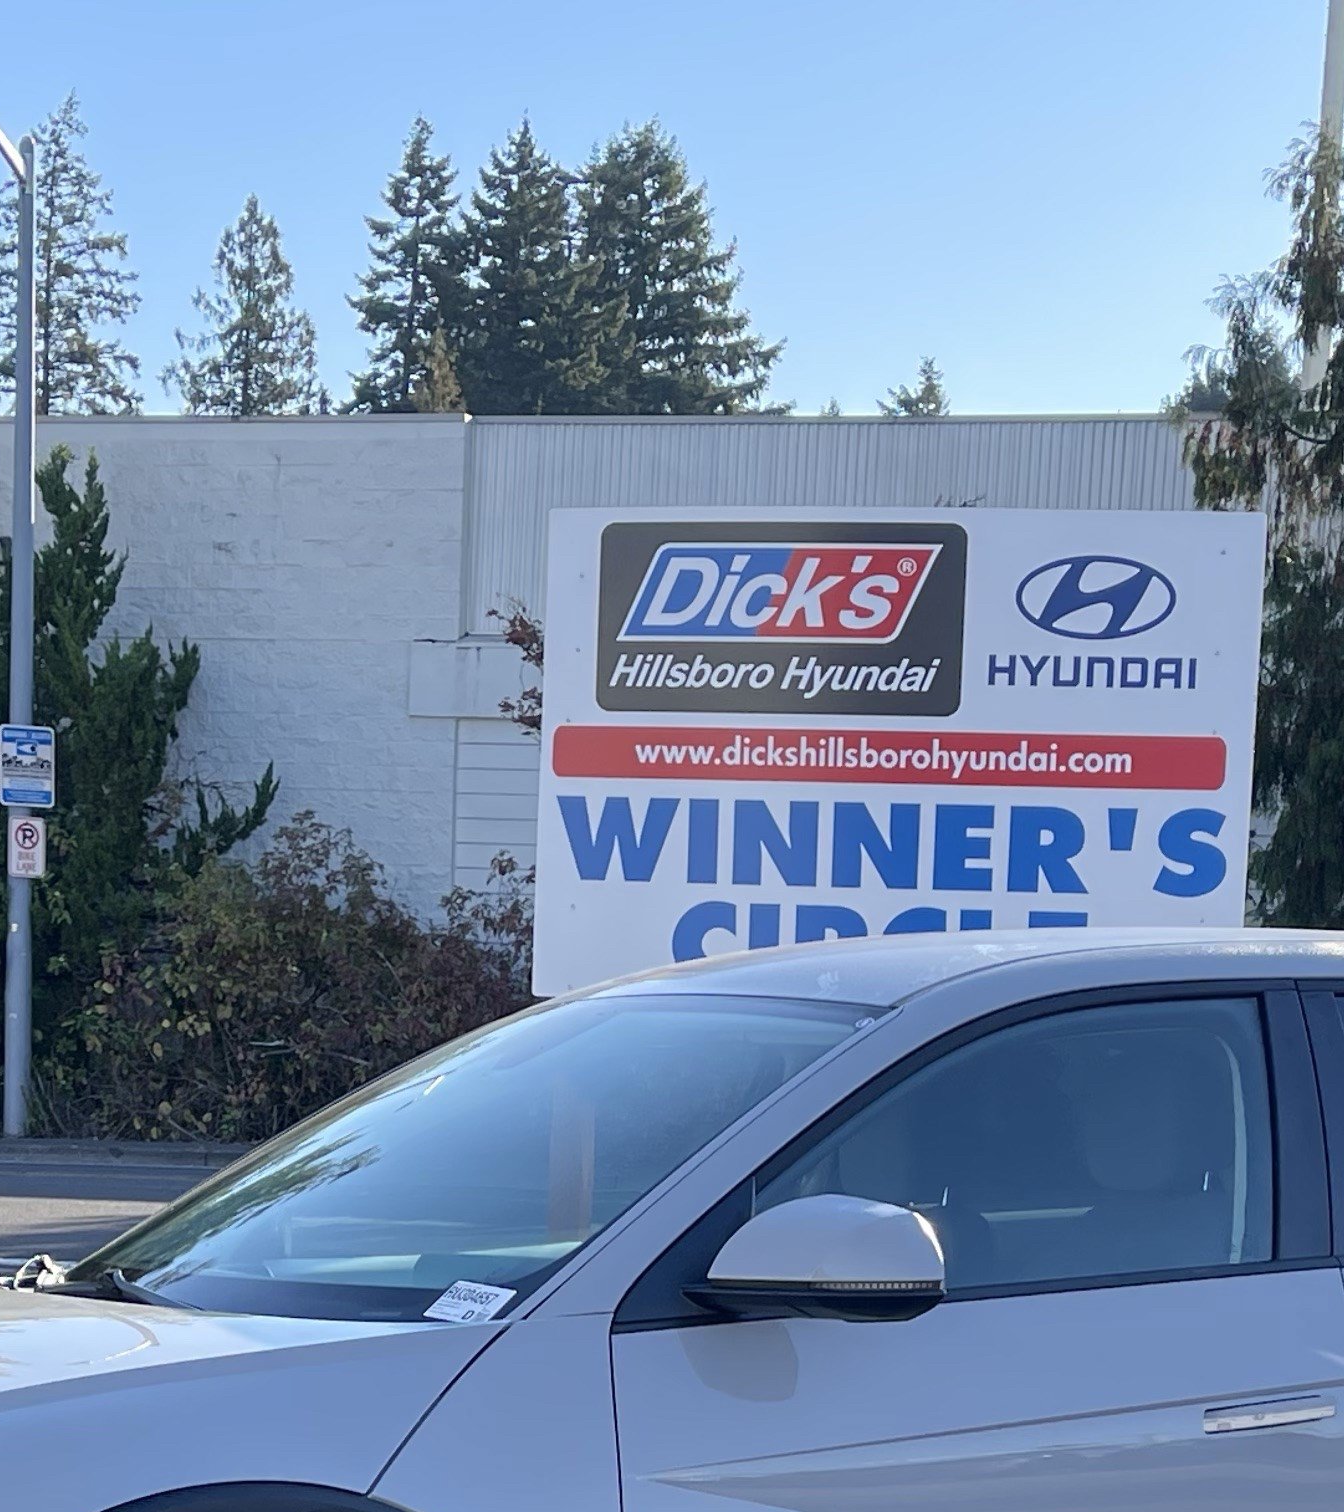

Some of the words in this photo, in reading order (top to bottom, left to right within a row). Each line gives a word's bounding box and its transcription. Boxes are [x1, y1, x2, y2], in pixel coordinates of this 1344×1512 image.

[641, 554, 900, 630] Dick's
[609, 653, 775, 690] Hillsboro
[780, 656, 941, 699] Hyundai
[987, 654, 1197, 690] HYUNDAI
[634, 735, 1133, 779] www.dickshillsborohyundai.com
[556, 795, 1227, 898] WINNER'S
